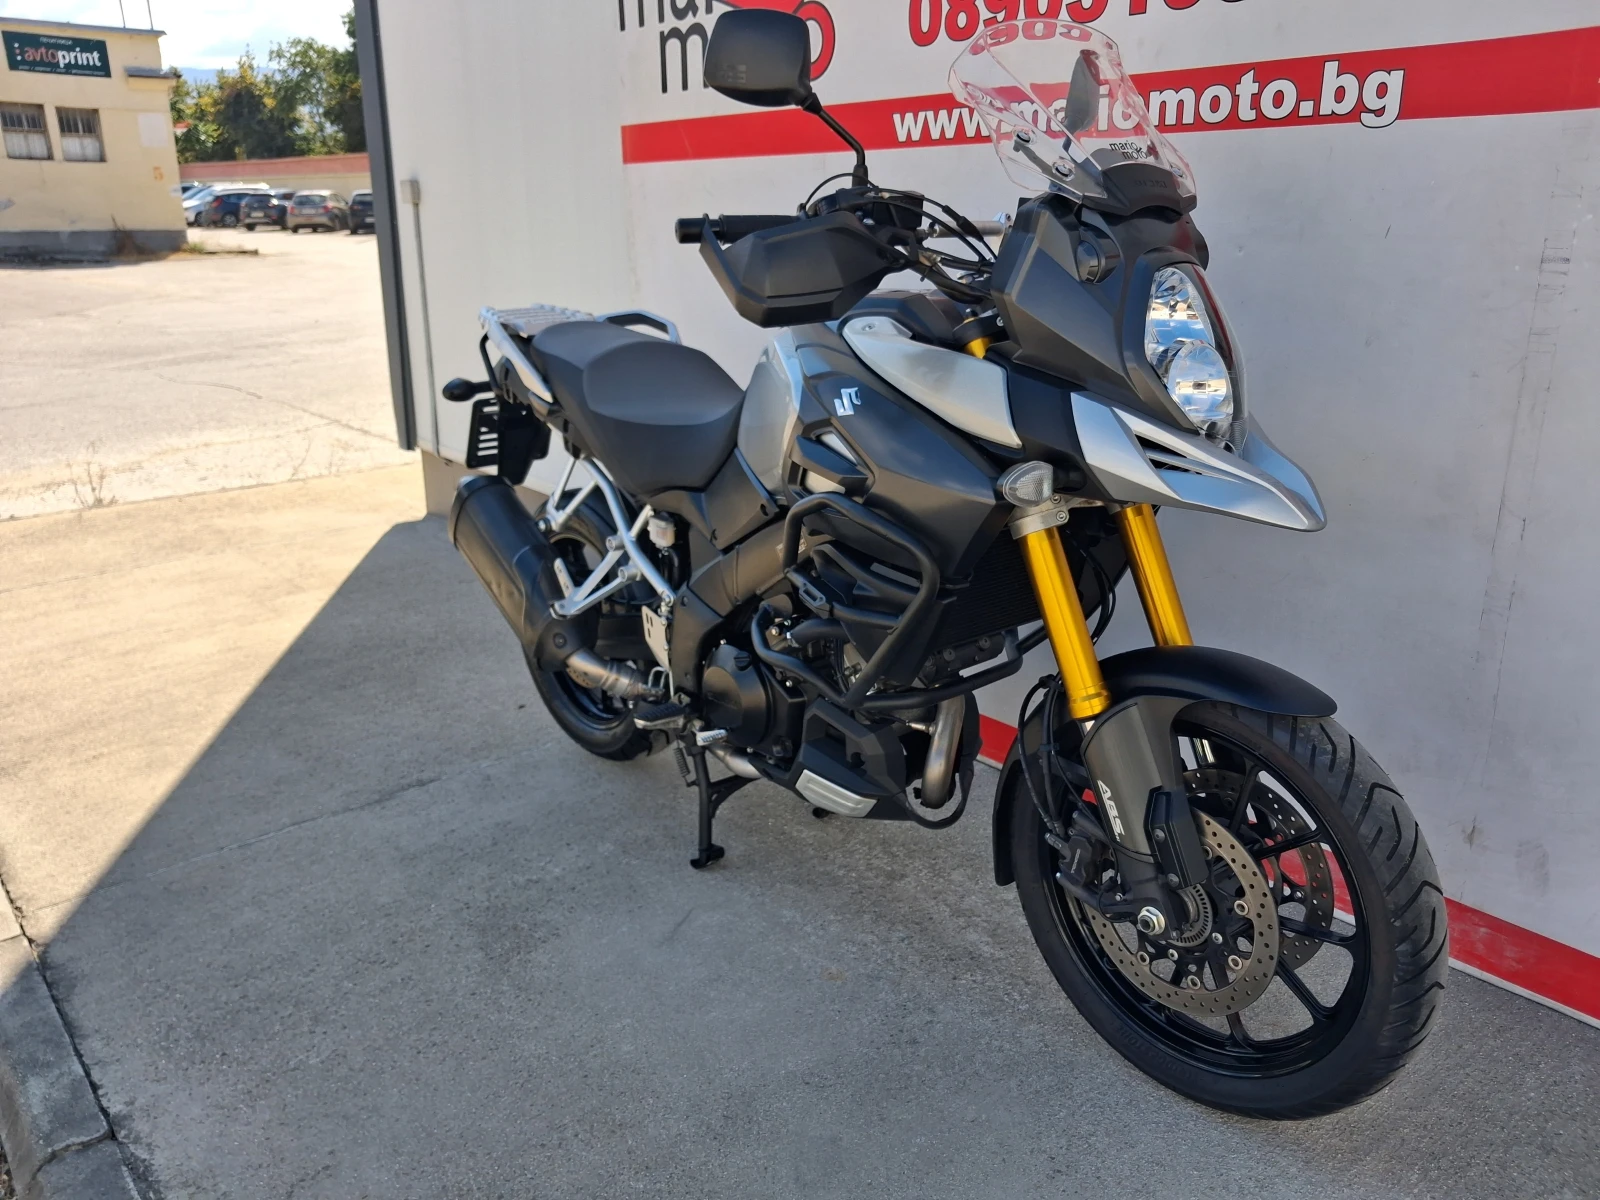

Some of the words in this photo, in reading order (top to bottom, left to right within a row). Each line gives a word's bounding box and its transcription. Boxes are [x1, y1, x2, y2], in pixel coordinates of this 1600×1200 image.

[24, 46, 102, 68] avtoprint
[1109, 140, 1139, 152] mario
[1121, 147, 1148, 160] moto
[1097, 780, 1125, 842] ABS
